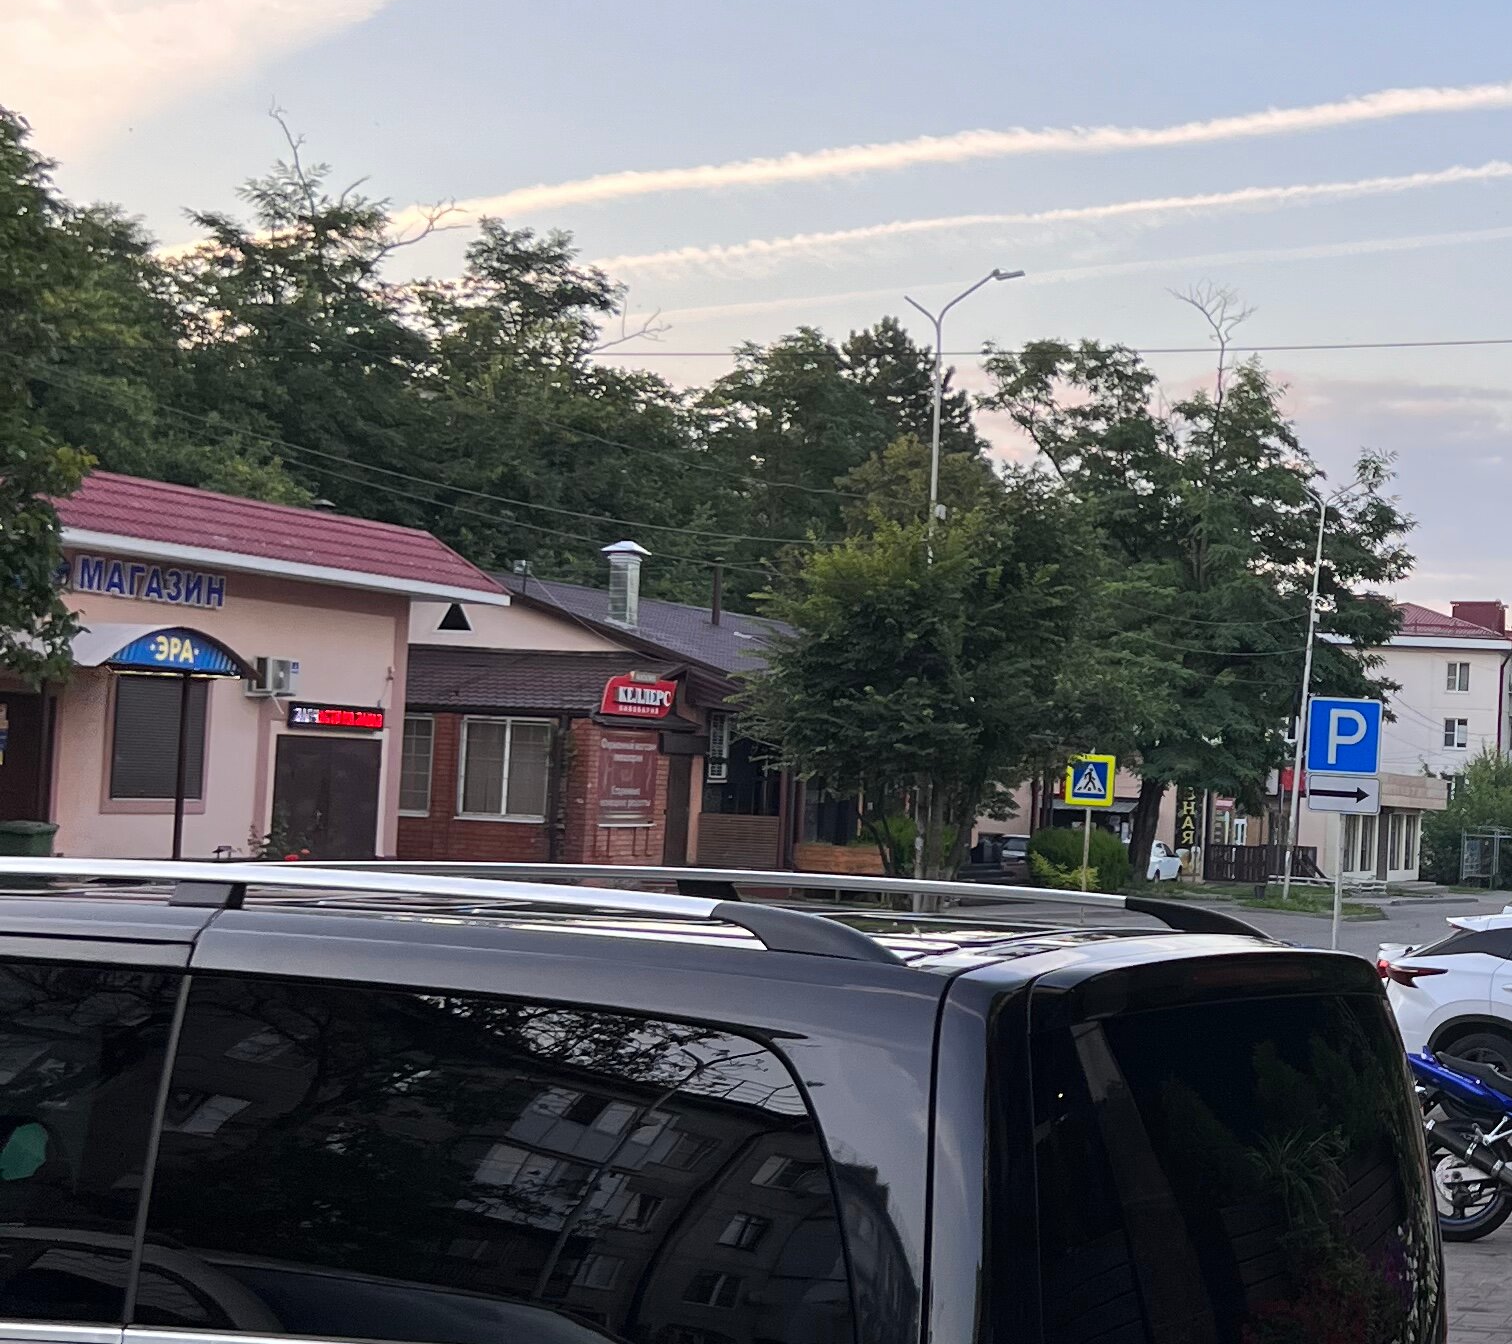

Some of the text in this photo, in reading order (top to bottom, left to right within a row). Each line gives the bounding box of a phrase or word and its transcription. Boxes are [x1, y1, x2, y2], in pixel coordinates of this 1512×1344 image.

[77, 557, 226, 608] МАГАЗИН
[154, 635, 195, 664] ЭРА
[1327, 708, 1368, 765] P
